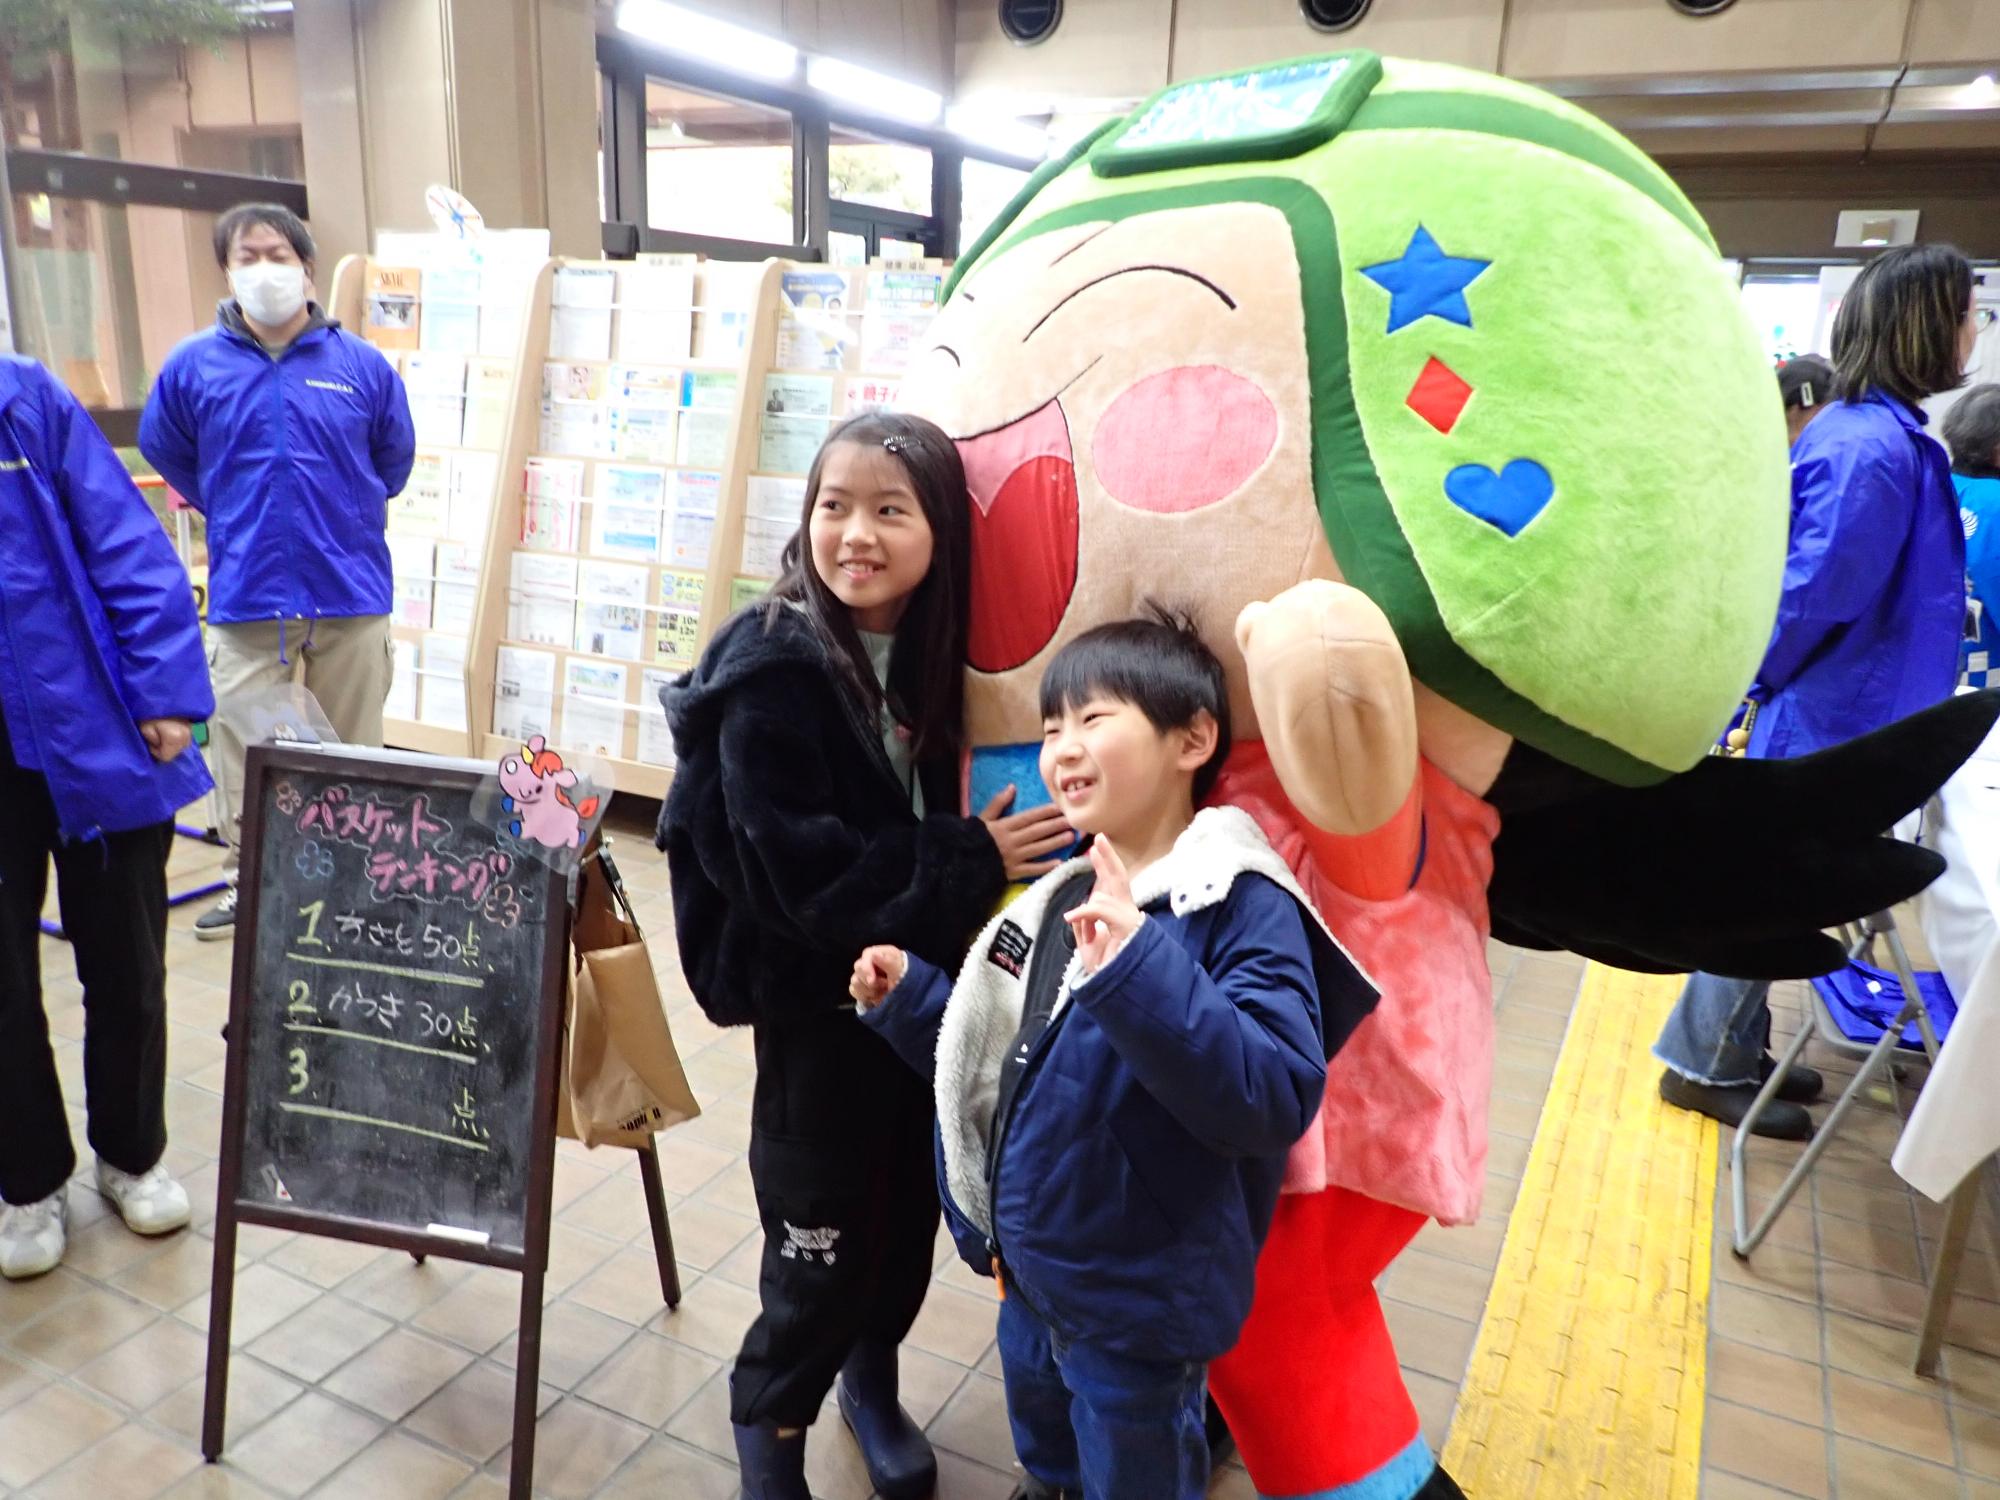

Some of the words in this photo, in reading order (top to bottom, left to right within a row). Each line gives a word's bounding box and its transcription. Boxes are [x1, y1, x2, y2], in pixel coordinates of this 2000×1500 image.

[300, 788, 440, 848] バスケット
[369, 851, 507, 900] ランキング
